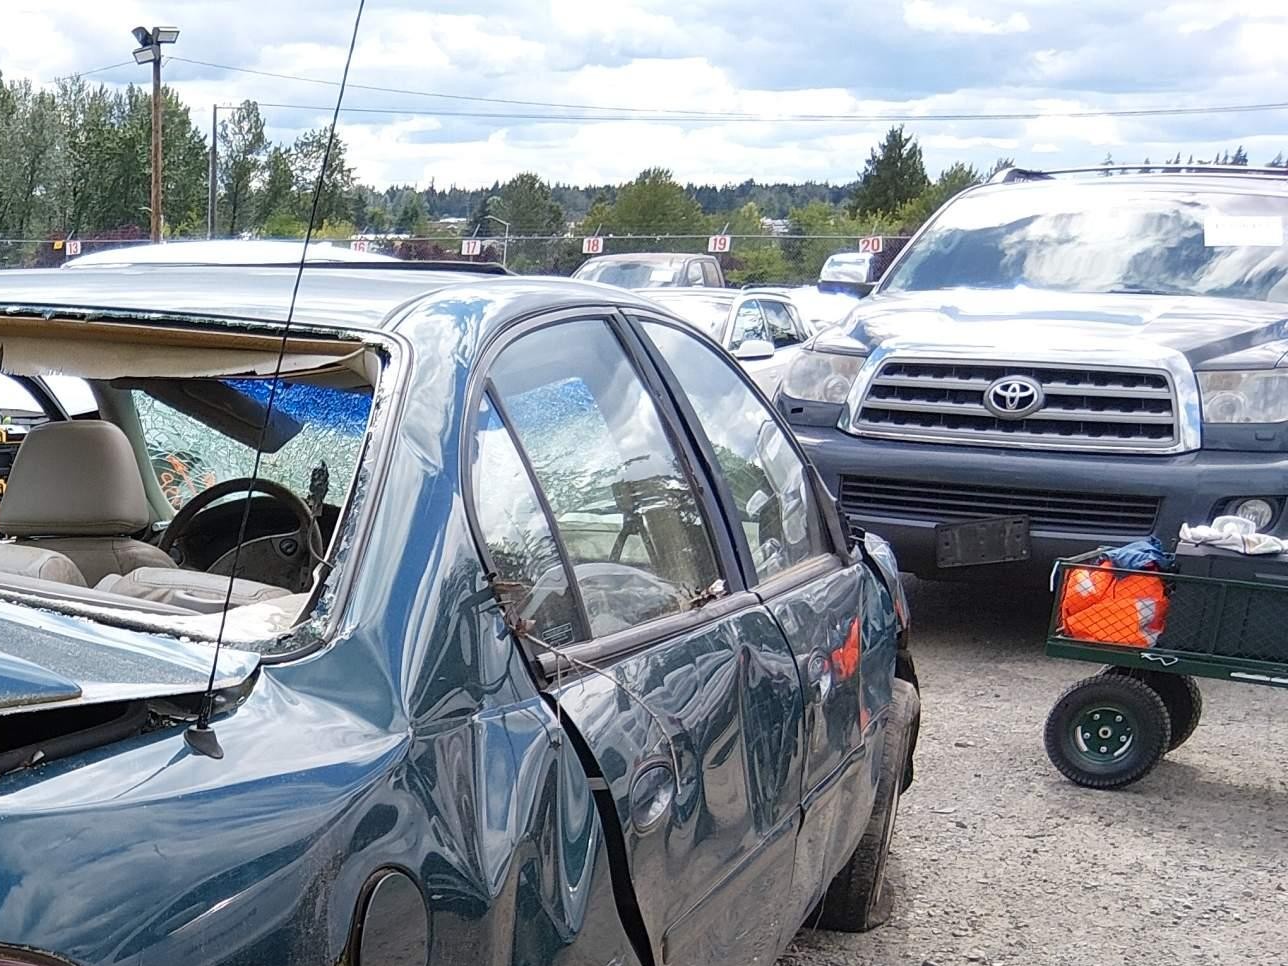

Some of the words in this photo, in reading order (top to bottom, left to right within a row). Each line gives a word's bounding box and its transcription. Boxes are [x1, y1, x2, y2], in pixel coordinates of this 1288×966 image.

[69, 242, 78, 254] 13
[353, 242, 365, 253] 16
[466, 241, 477, 254] 17
[586, 238, 600, 252] 18
[712, 236, 727, 251] 19
[861, 238, 880, 253] 20
